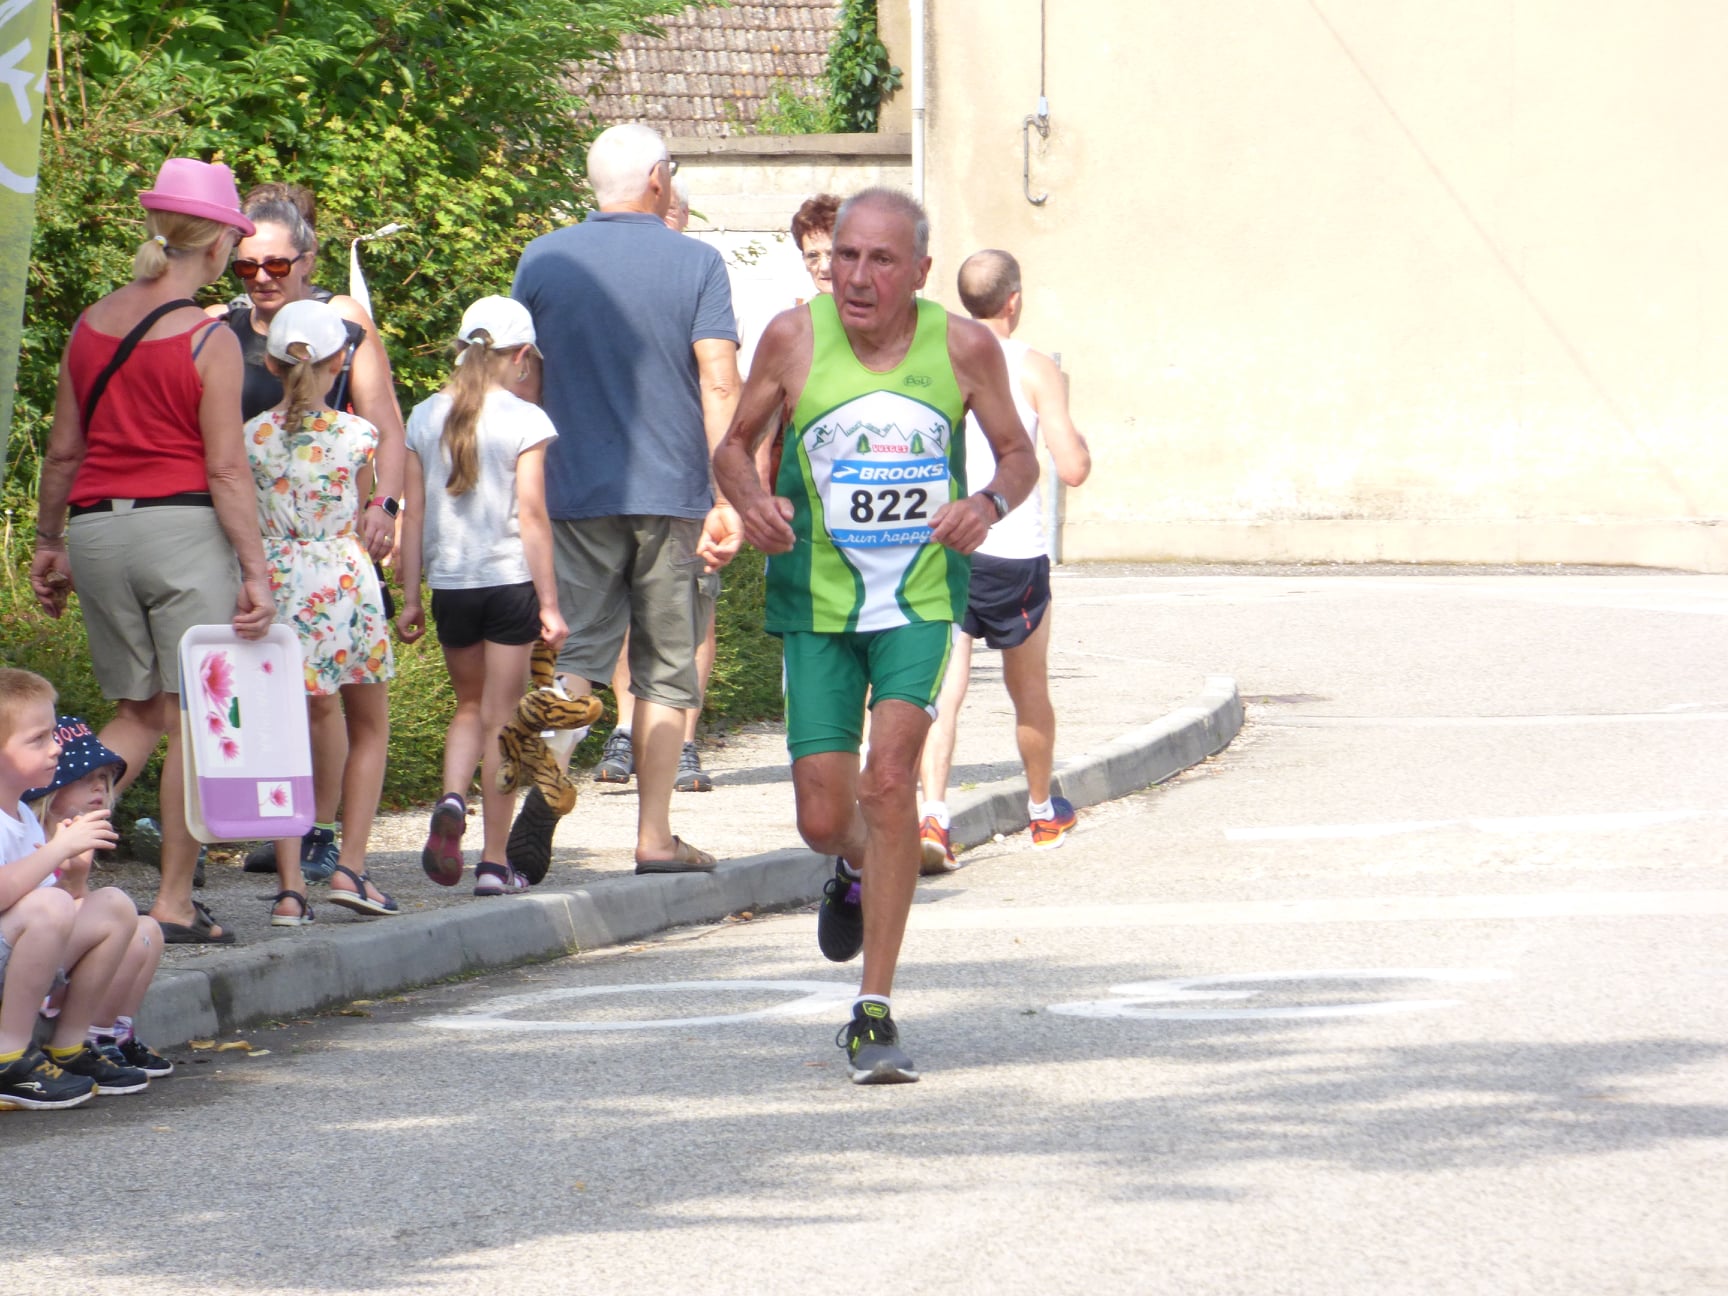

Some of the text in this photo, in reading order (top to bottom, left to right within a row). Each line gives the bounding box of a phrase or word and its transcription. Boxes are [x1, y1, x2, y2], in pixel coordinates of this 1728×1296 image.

[859, 463, 945, 481] BROOKS
[850, 488, 928, 523] 822
[845, 530, 930, 544] run happy
